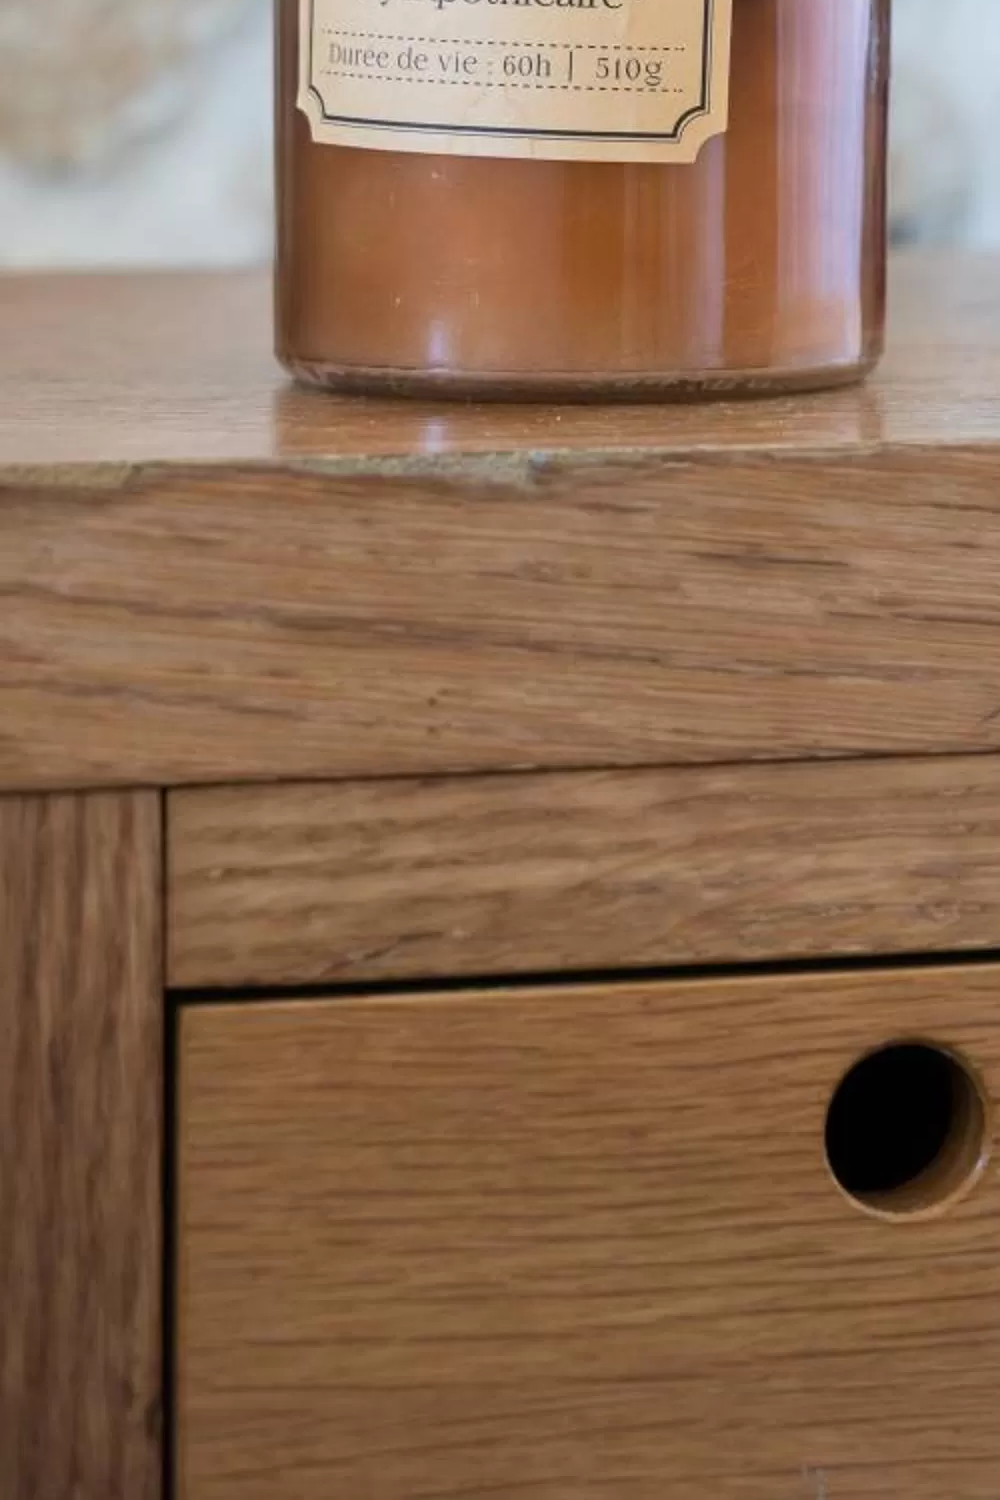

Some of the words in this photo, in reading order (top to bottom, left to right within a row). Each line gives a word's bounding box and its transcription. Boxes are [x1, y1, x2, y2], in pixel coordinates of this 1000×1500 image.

[397, 46, 428, 71] de
[438, 51, 478, 75] vie
[503, 53, 550, 77] 60h
[595, 56, 662, 87] 510g
